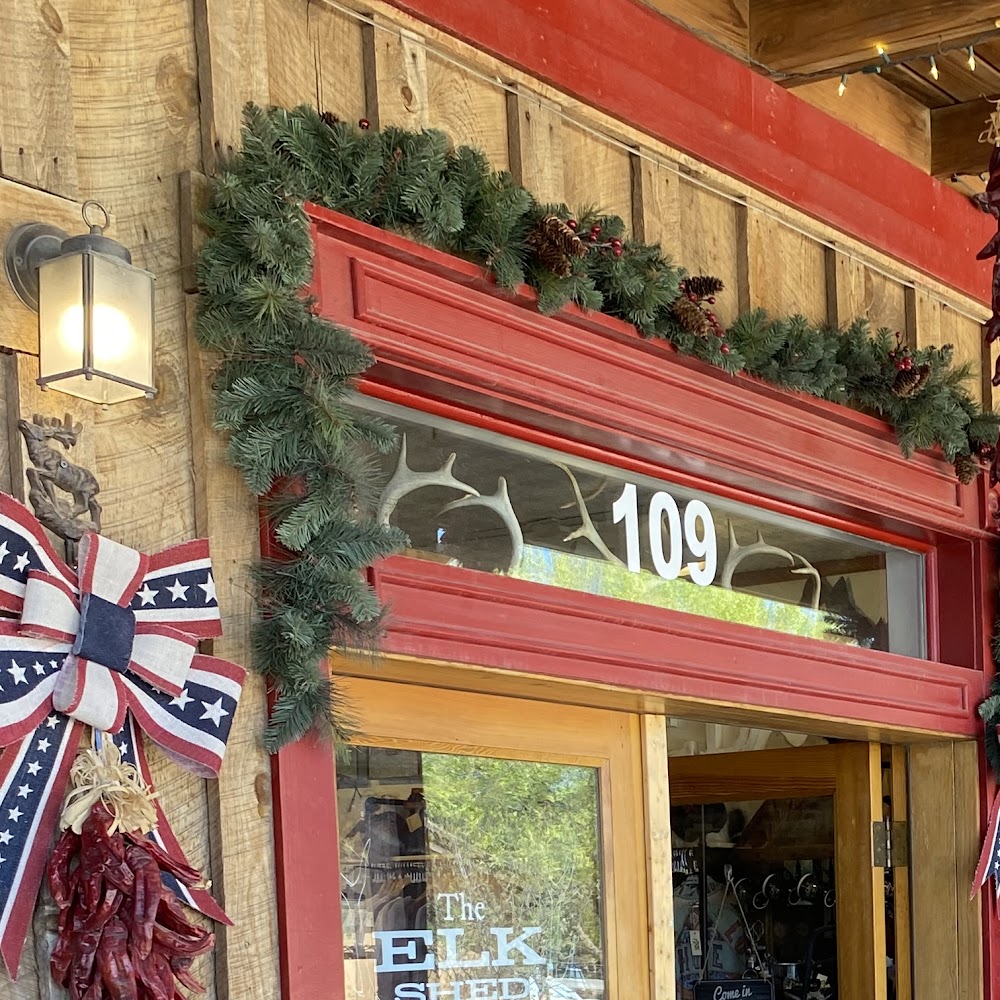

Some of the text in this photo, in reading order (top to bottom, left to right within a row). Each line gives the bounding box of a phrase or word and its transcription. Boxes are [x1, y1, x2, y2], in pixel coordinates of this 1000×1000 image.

[612, 483, 717, 587] 109
[437, 892, 486, 922] The
[372, 926, 546, 973] ELK
[741, 984, 753, 998] in
